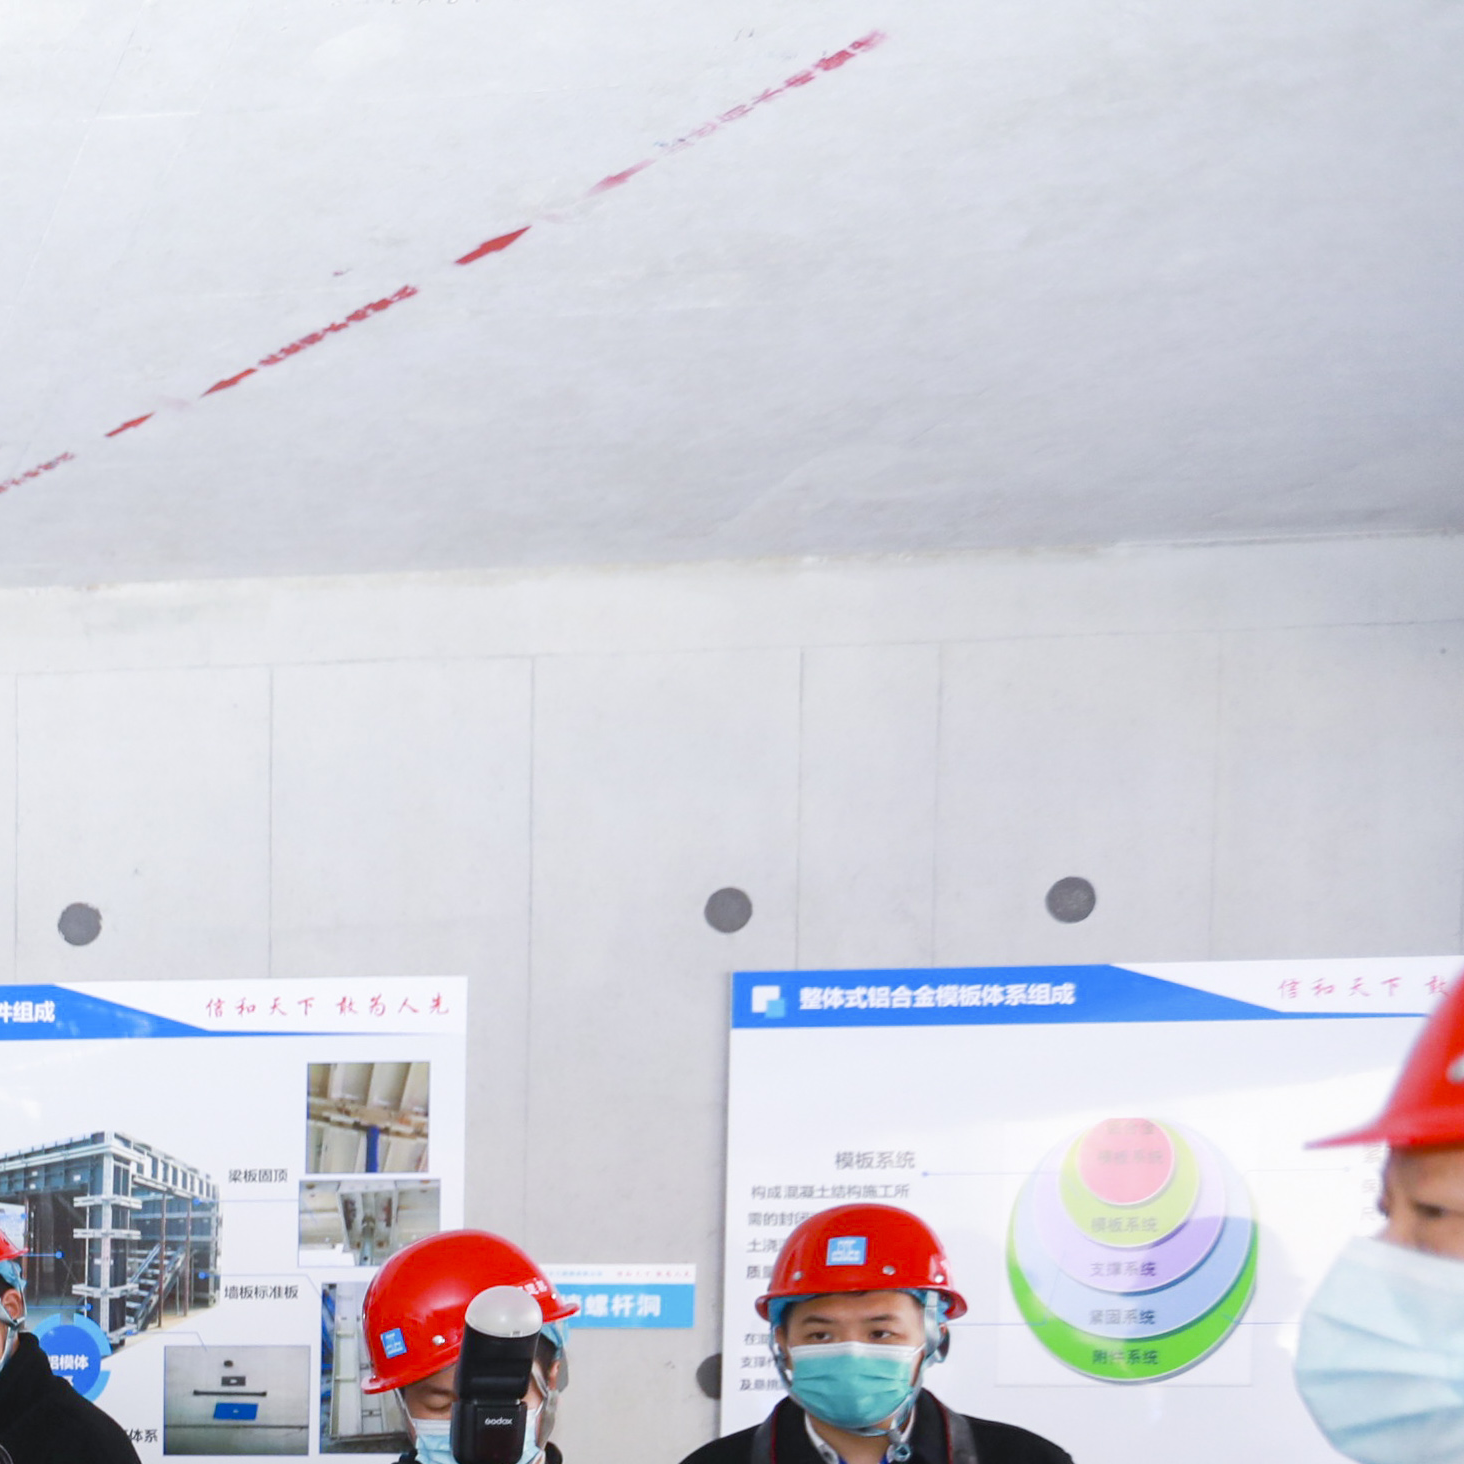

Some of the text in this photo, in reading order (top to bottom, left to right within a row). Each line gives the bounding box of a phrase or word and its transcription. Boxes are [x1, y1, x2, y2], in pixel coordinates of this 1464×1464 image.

[799, 982, 1076, 1010] 整体式铝合金模板体系组成
[1278, 976, 1402, 999] 信和天下
[206, 992, 450, 1017] 信和天下 敢为人先
[835, 1151, 915, 1170] 模板系统
[224, 1285, 299, 1300] 墙板标准板
[484, 1417, 513, 1426] Godox
